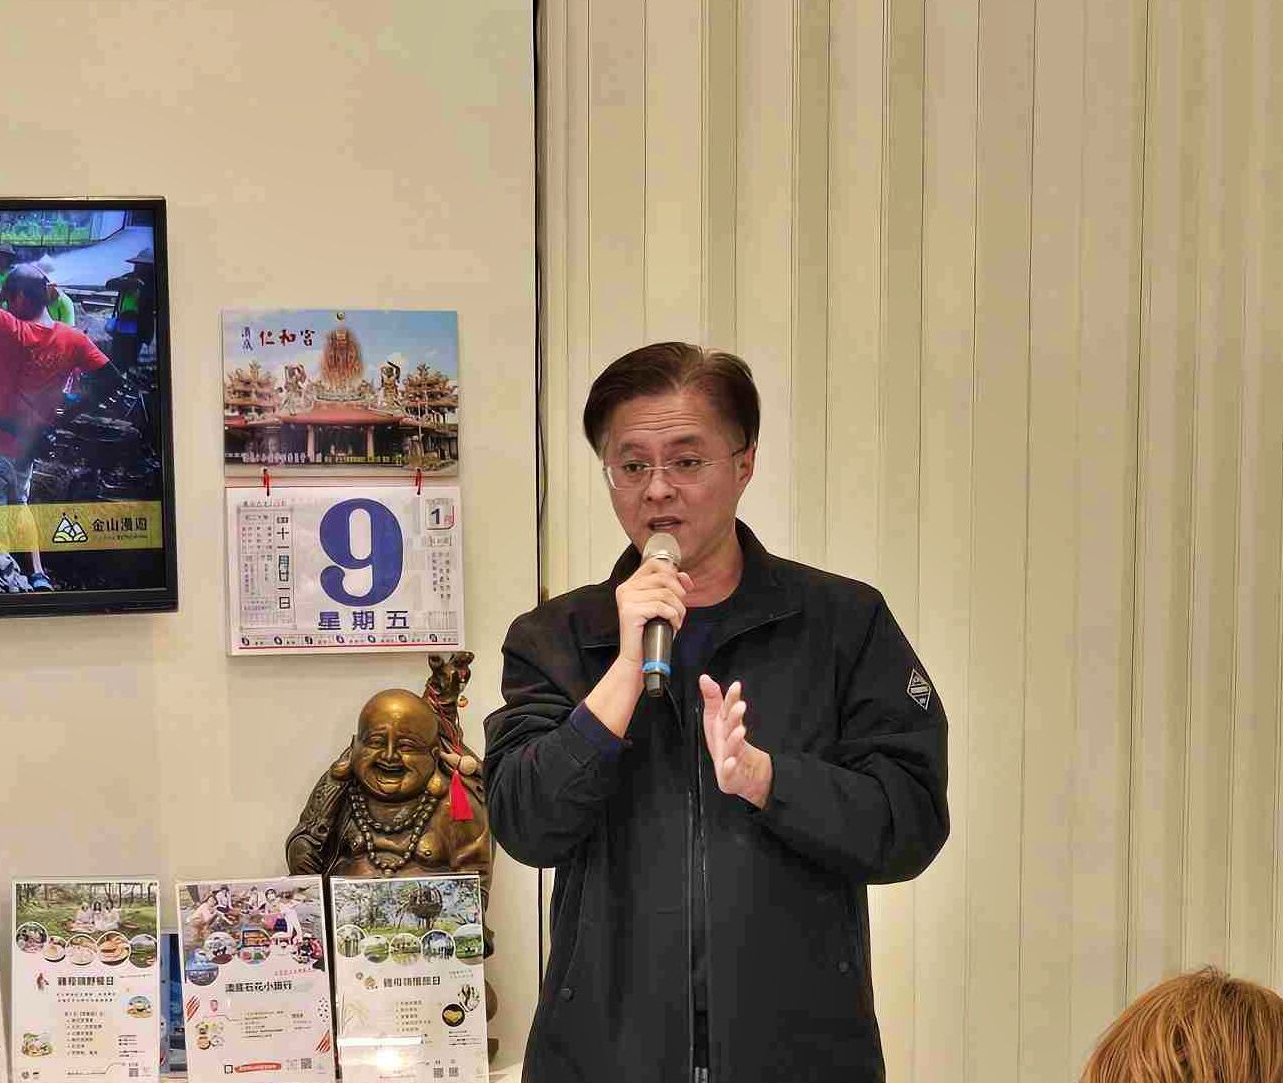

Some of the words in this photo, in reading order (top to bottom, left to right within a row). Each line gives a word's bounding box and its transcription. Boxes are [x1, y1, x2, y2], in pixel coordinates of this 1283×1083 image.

[260, 329, 315, 347] 仁和宮
[319, 497, 404, 608] 9
[318, 610, 410, 631] 星期五
